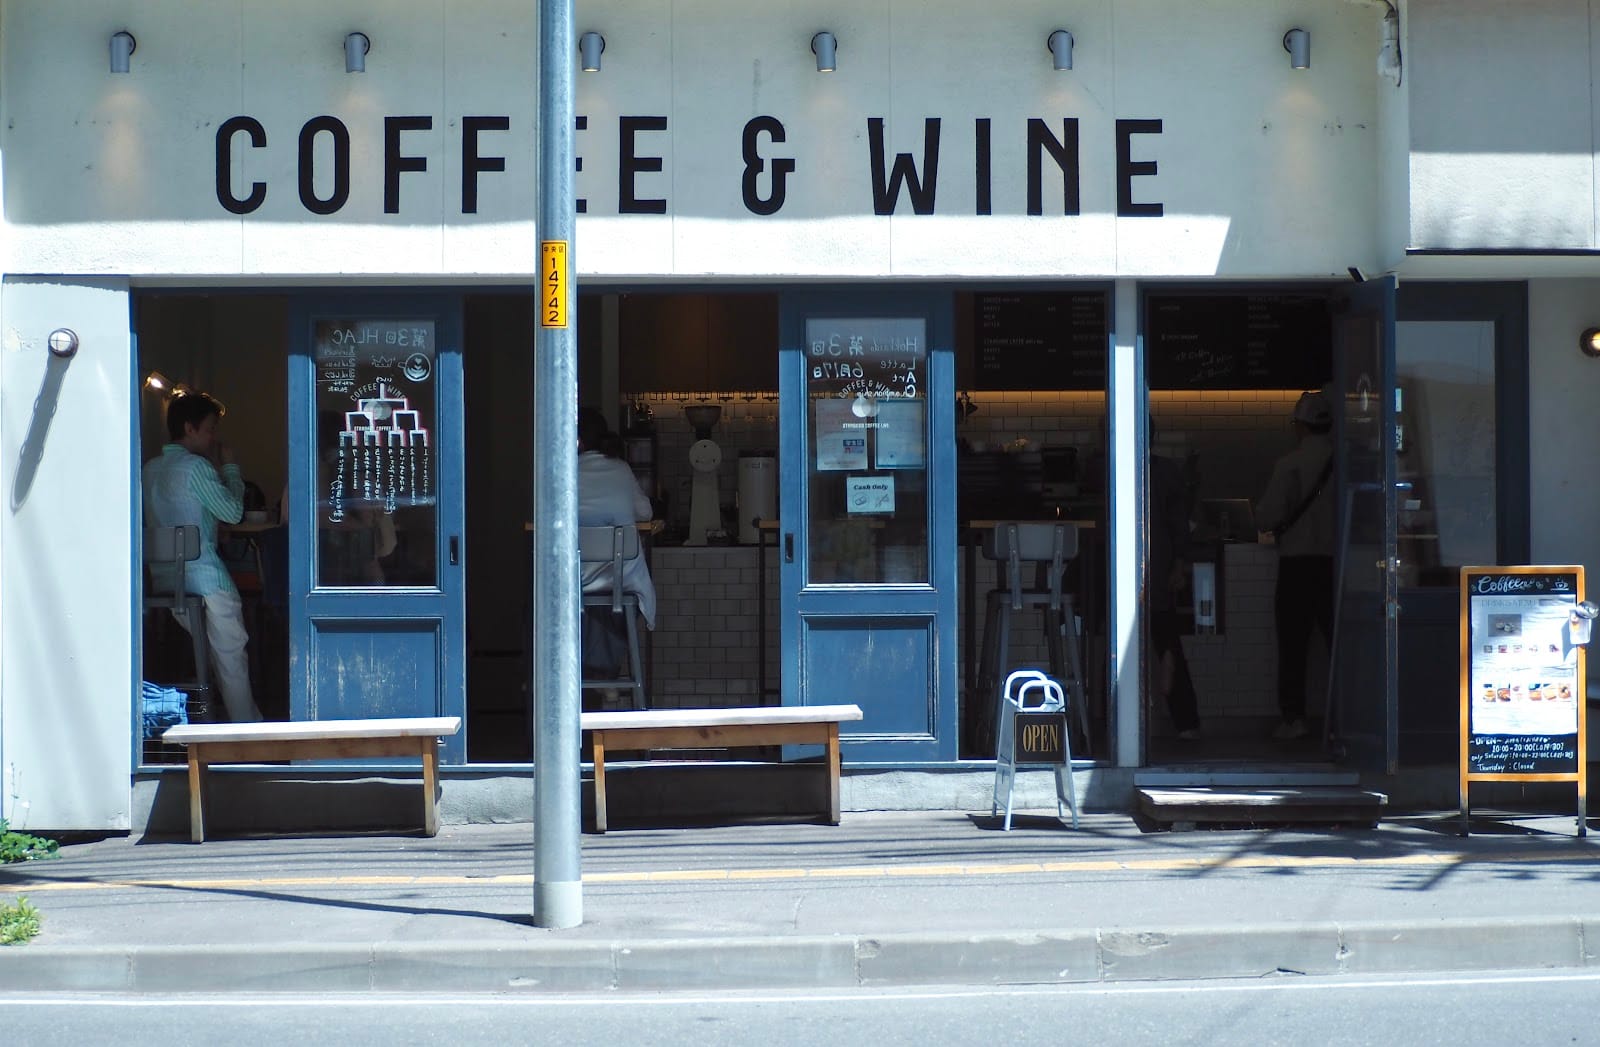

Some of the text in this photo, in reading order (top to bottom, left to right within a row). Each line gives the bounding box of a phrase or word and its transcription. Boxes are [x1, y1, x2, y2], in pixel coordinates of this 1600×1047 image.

[216, 116, 1163, 217] COFFE & WINE
[543, 245, 564, 253] 中央区
[548, 257, 559, 322] 14742
[350, 382, 377, 402] COFFEE
[838, 379, 866, 399] COFFEE
[1478, 575, 1524, 593] Coffee
[1022, 724, 1058, 752] OPEN
